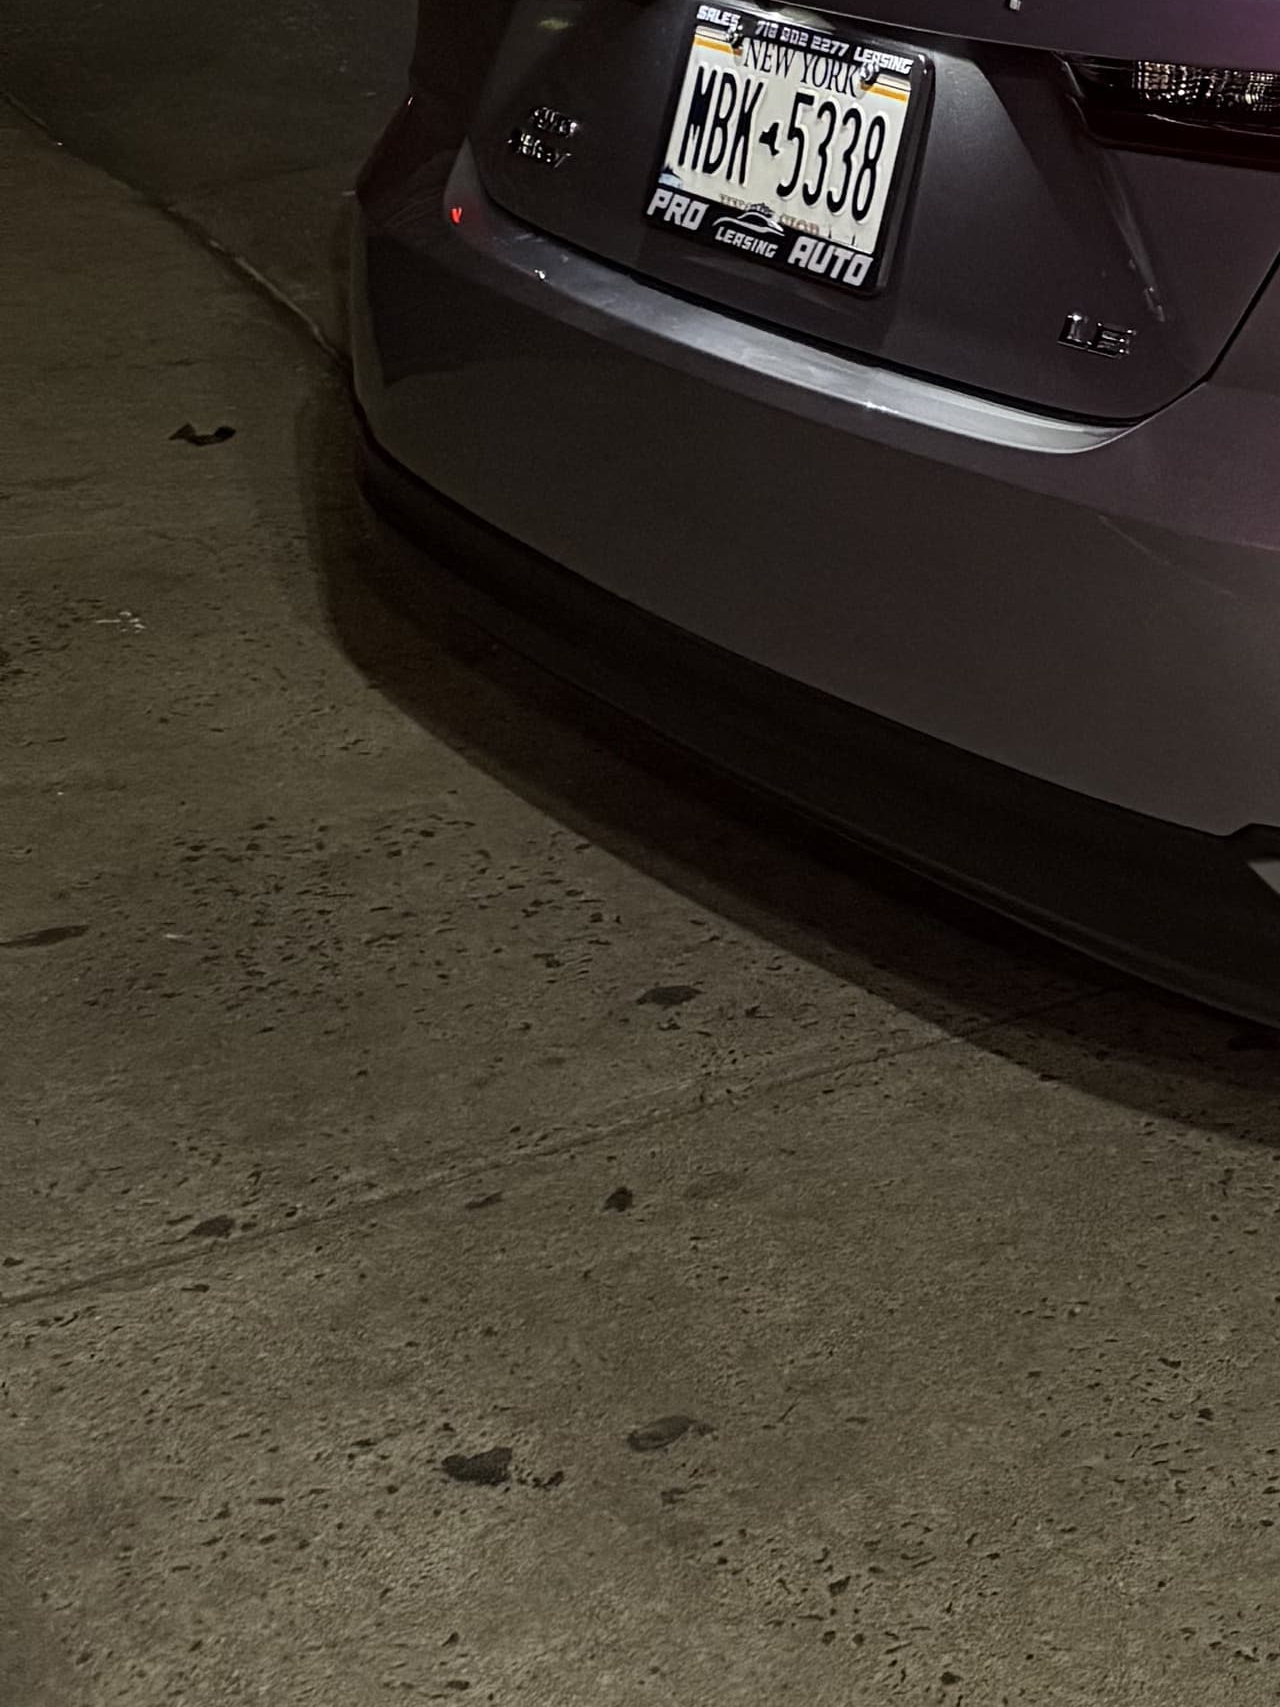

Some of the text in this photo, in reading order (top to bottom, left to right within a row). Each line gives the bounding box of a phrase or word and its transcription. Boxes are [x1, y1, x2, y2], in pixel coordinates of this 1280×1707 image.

[696, 4, 740, 29] SALES
[810, 35, 850, 57] 2277
[853, 46, 915, 75] LEASING
[744, 38, 861, 98] NEW YORK
[677, 64, 886, 222] MBK 5338
[646, 188, 710, 232] PRO
[787, 235, 875, 287] AUTO
[714, 225, 779, 259] LEASING
